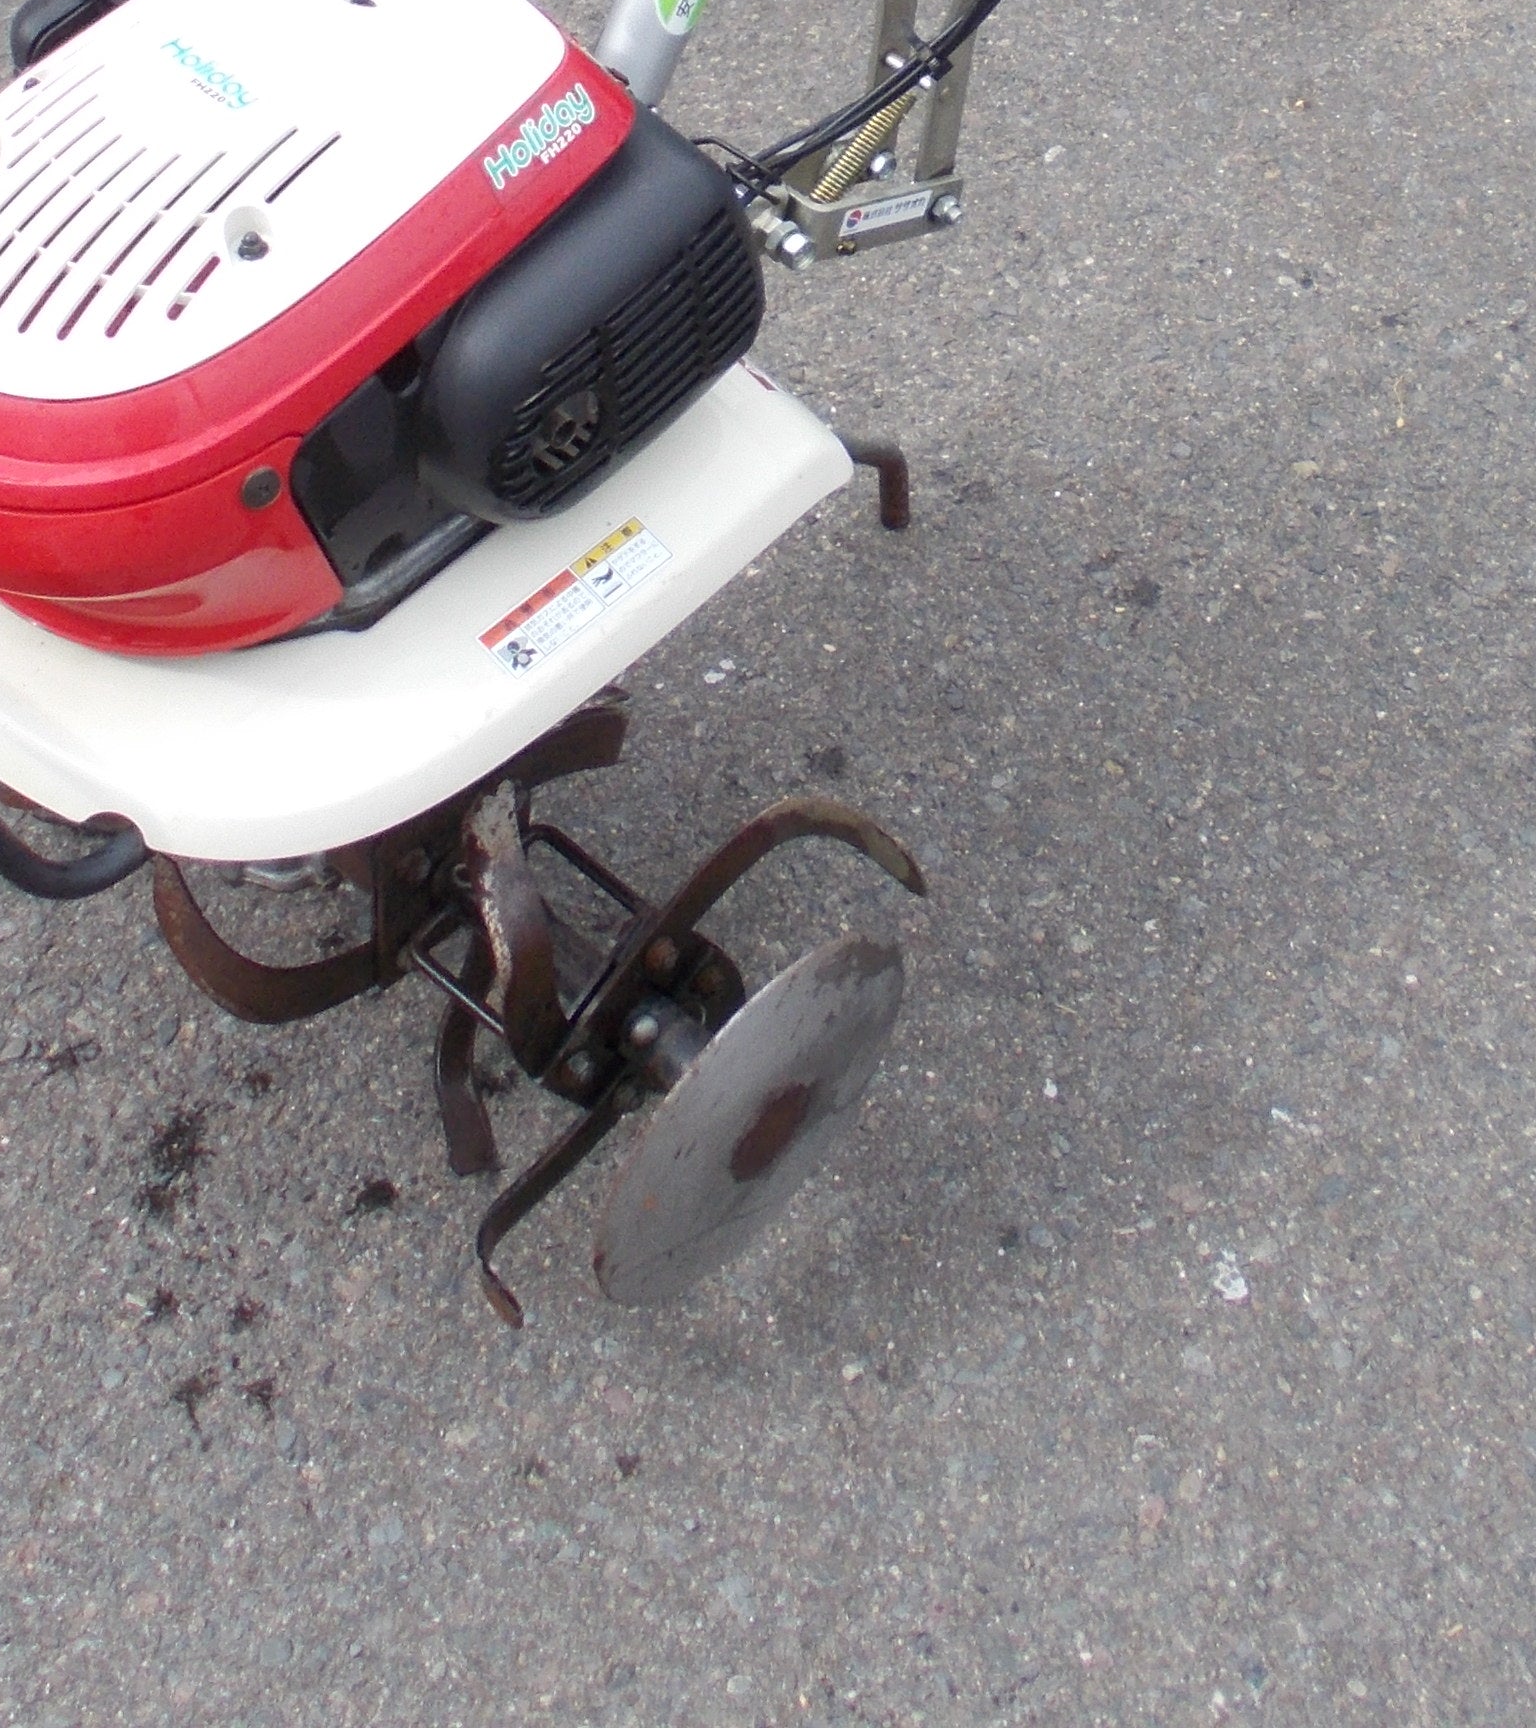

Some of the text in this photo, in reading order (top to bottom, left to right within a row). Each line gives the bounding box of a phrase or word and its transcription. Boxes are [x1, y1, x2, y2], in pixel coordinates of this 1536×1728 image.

[160, 38, 259, 109] Holiday
[190, 78, 226, 103] FH220
[484, 83, 595, 189] Holiday
[539, 124, 582, 164] FH220
